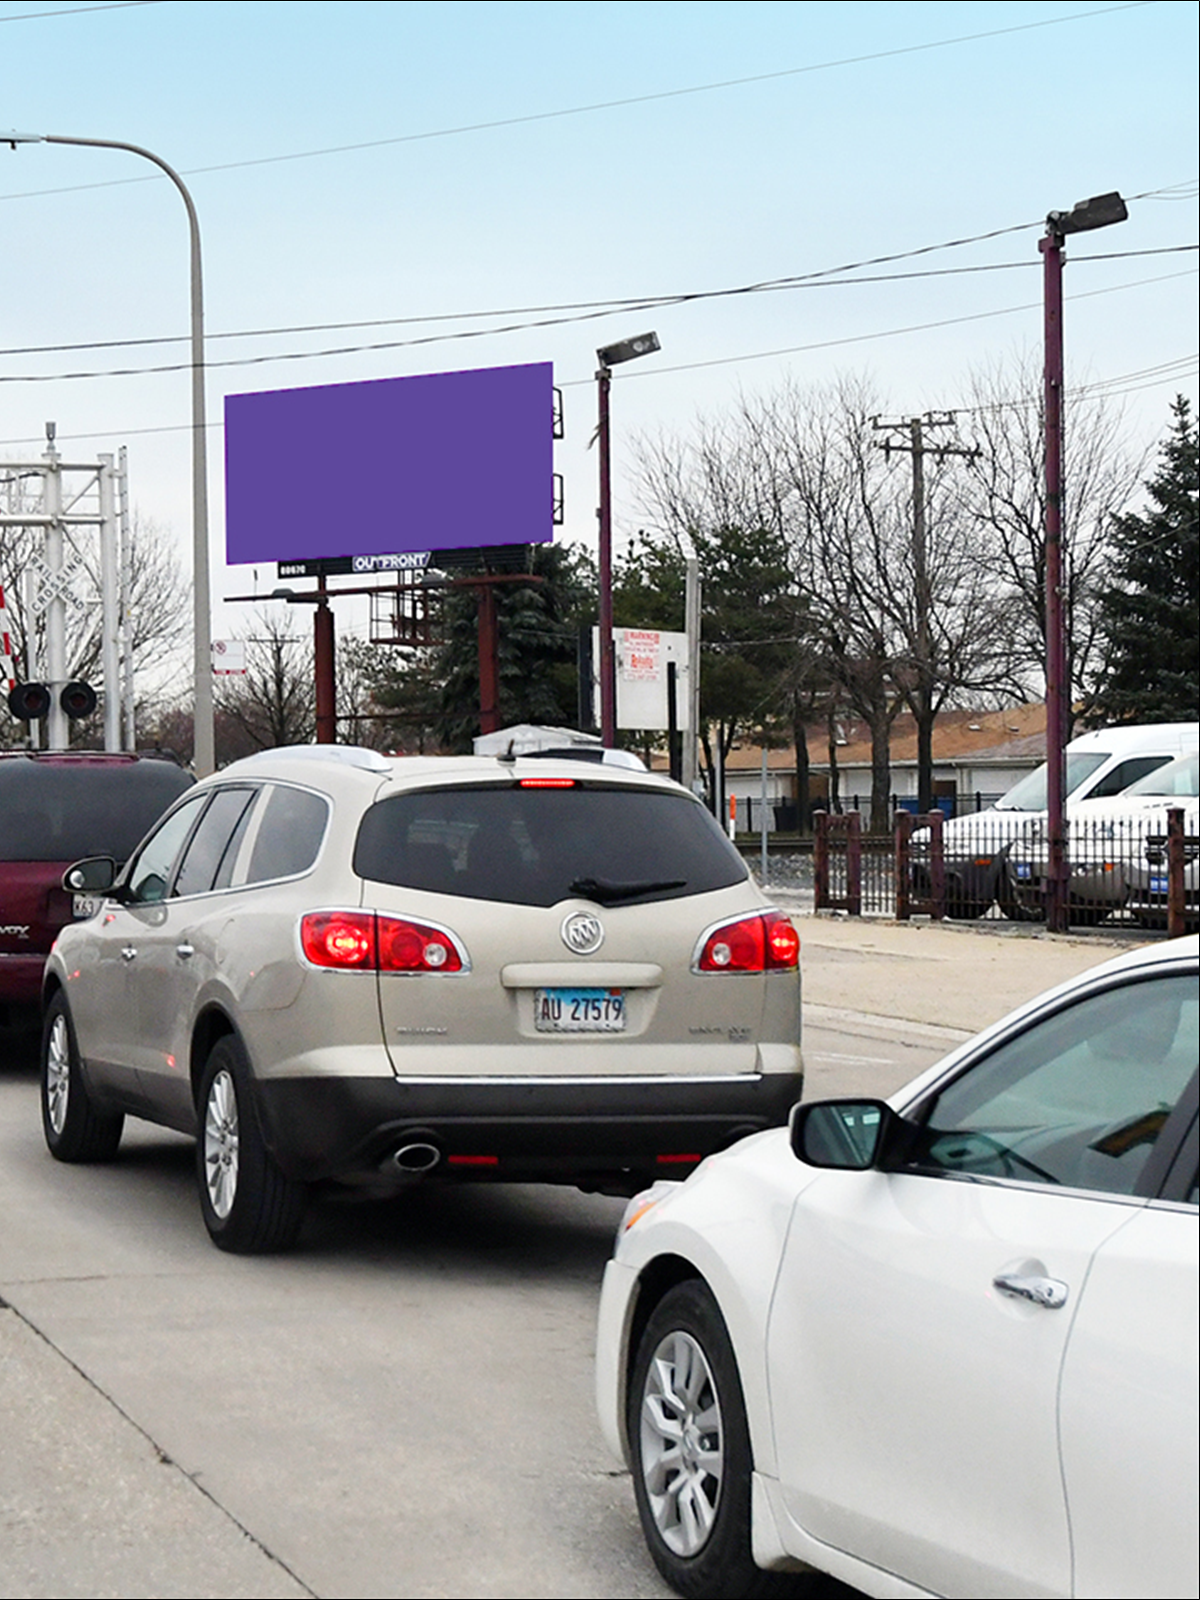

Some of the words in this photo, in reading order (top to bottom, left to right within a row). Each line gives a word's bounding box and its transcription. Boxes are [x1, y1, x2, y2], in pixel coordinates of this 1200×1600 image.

[30, 556, 52, 582] RAIL
[59, 585, 85, 611] ROAD
[31, 555, 83, 612] CROSSING
[542, 998, 562, 1021] AU
[571, 998, 623, 1021] 27579
